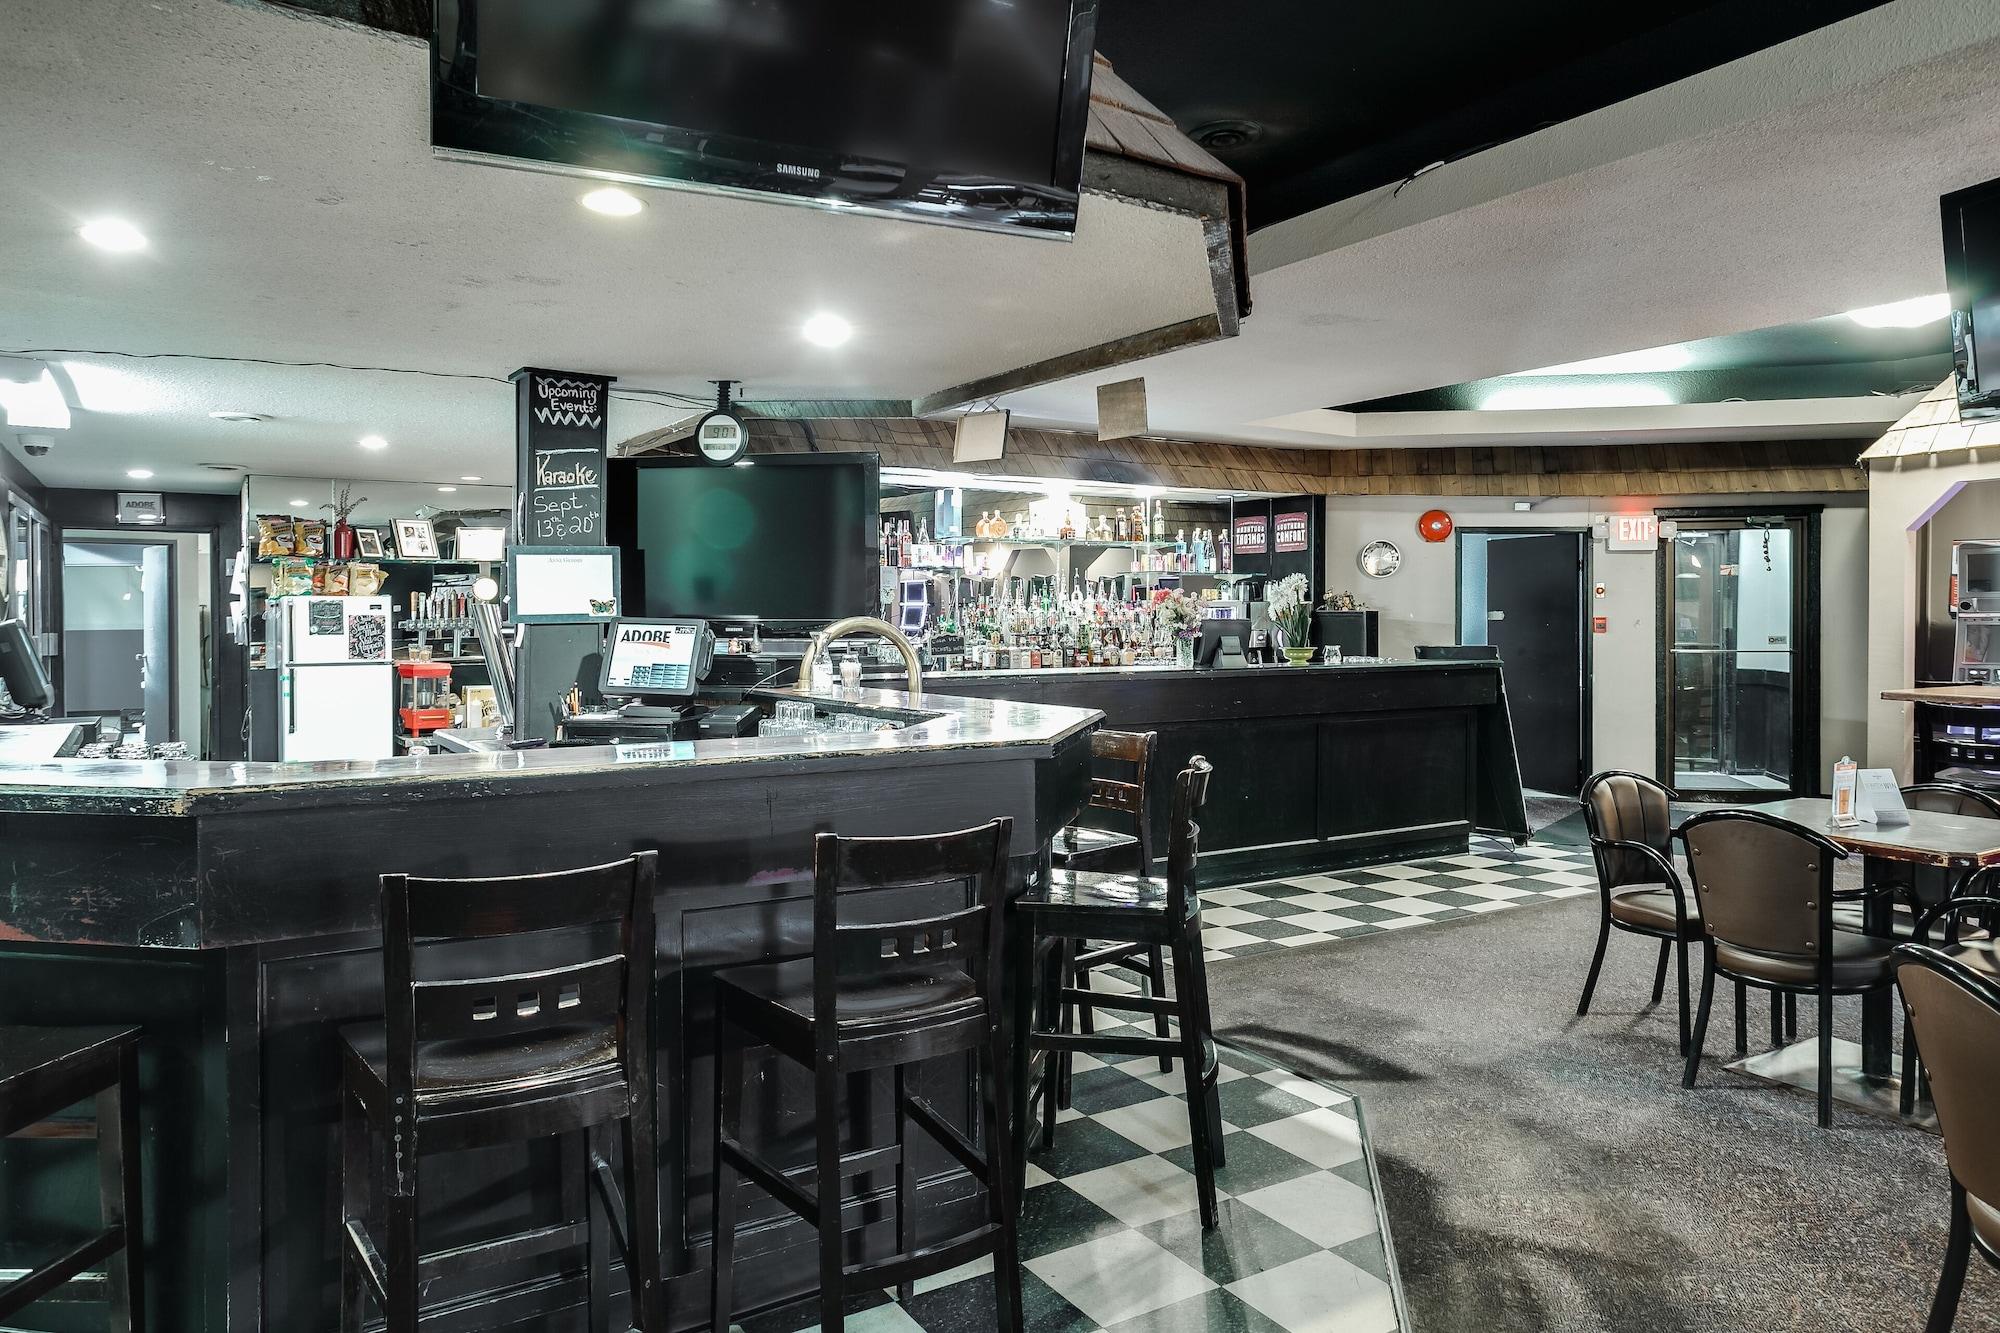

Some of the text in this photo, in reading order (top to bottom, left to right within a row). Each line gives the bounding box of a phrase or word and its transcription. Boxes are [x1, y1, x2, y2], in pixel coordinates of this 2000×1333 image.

[776, 163, 820, 178] SAMSUNG
[538, 384, 597, 405] Upcoming
[550, 398, 598, 413] Events:
[536, 454, 598, 486] Karaoke
[534, 492, 588, 518] Sept.
[1276, 530, 1306, 543] COMFORT
[1619, 518, 1651, 540] EXIT
